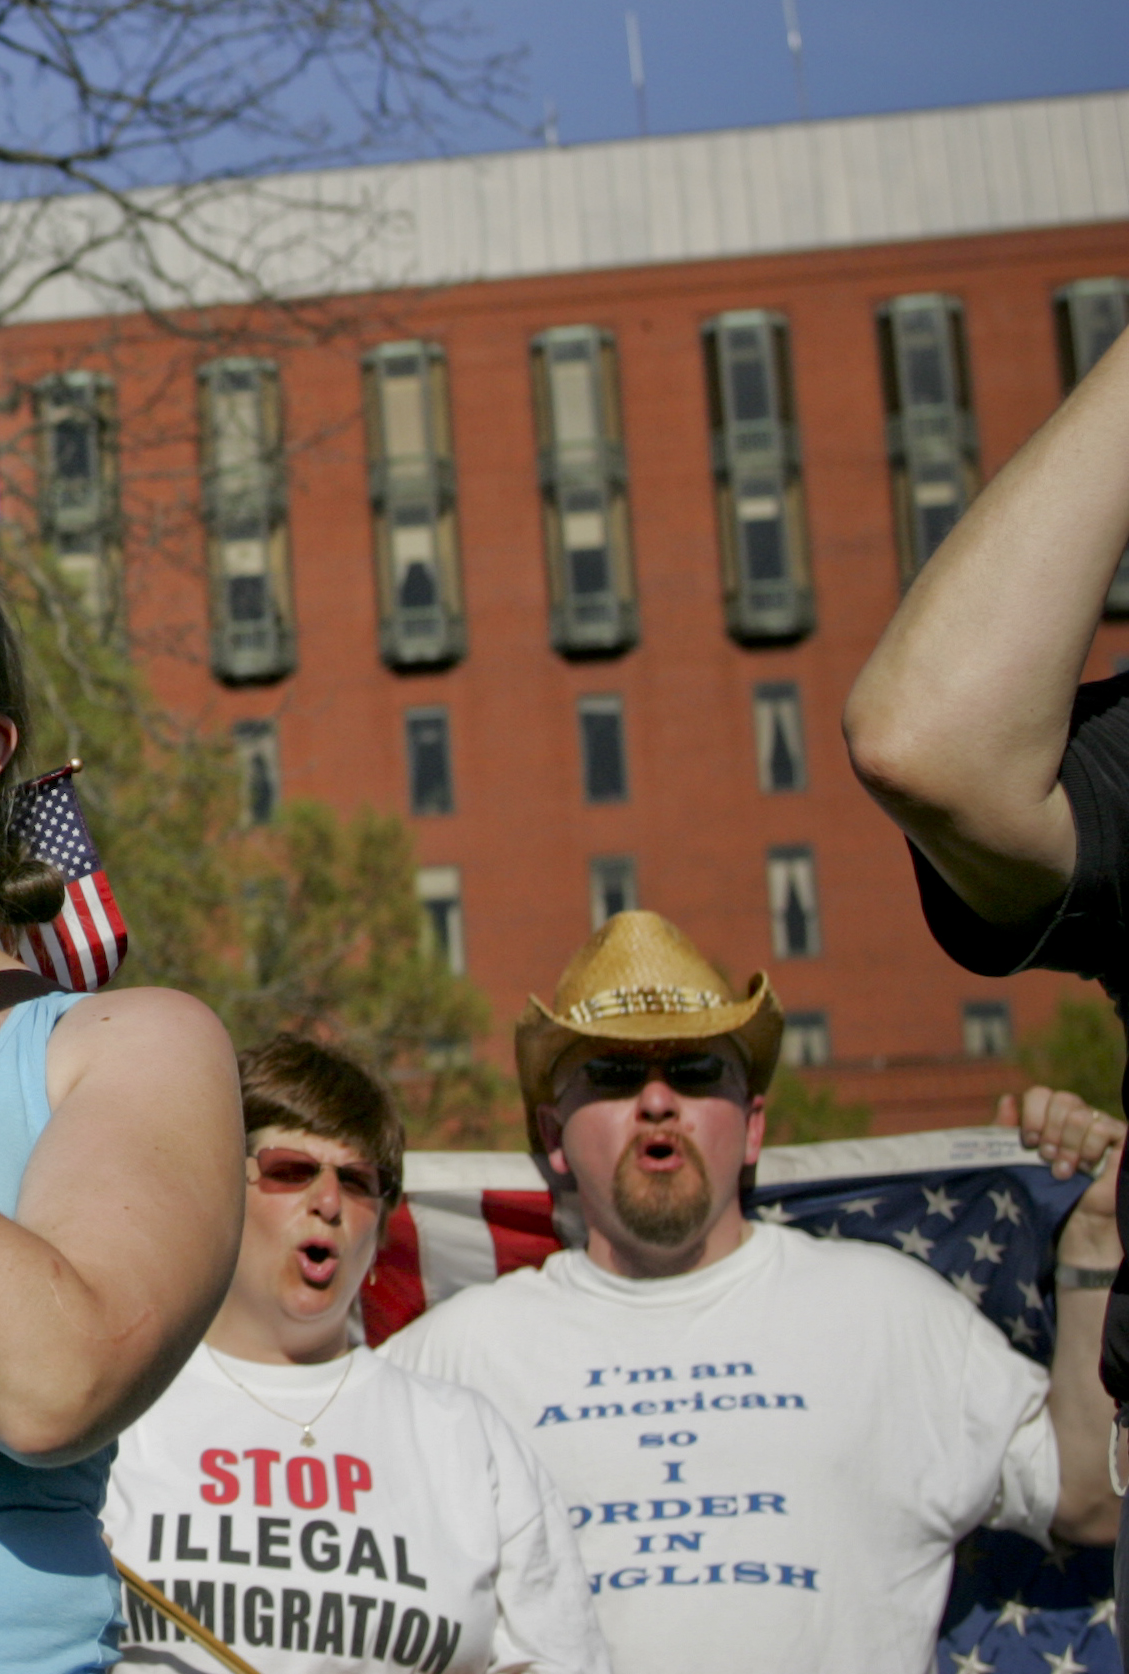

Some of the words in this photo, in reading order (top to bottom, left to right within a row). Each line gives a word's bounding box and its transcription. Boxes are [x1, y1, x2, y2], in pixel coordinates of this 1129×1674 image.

[584, 1363, 675, 1388] I'm
[690, 1360, 756, 1380] an
[534, 1390, 808, 1429] American
[637, 1429, 699, 1449] so
[199, 1447, 373, 1515] STOP
[661, 1459, 687, 1484] I
[147, 1512, 428, 1592] ILLEGAL
[633, 1530, 706, 1554] IN
[587, 1560, 820, 1595] GLISH
[120, 1577, 463, 1674] MMIGRATION
